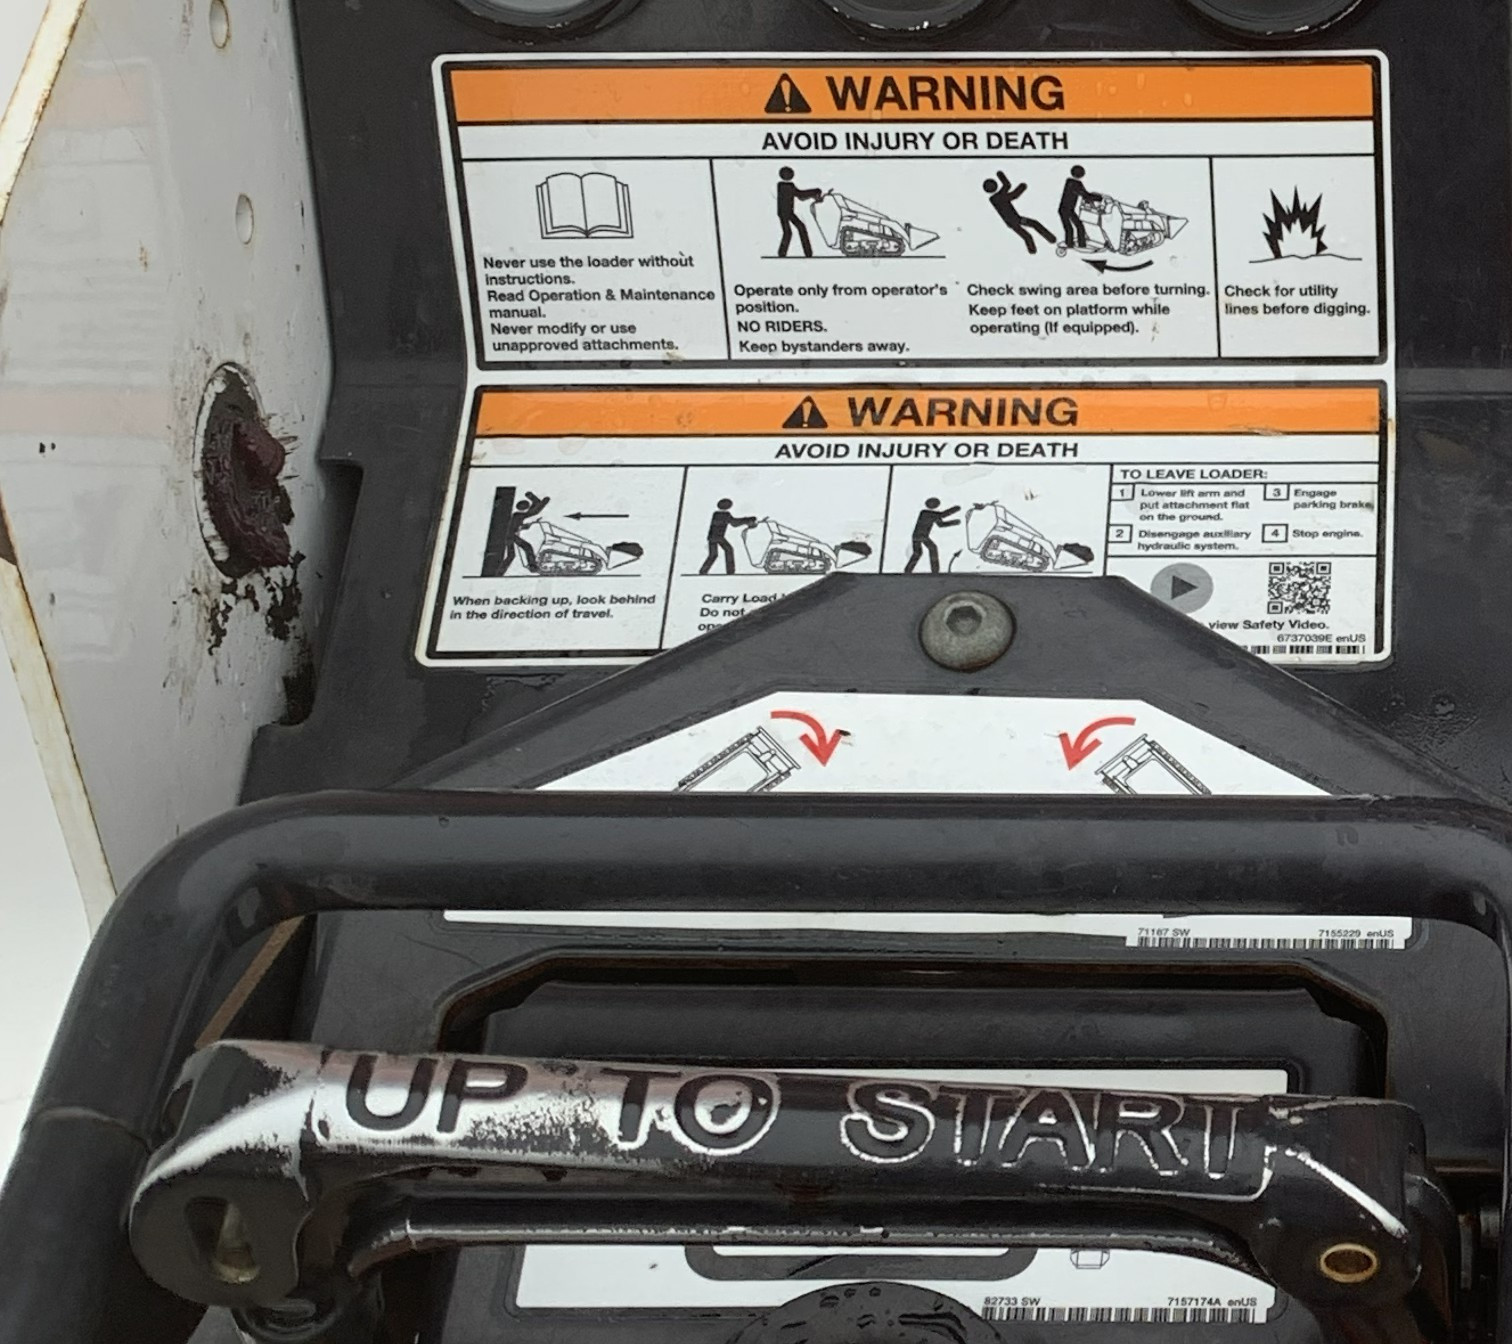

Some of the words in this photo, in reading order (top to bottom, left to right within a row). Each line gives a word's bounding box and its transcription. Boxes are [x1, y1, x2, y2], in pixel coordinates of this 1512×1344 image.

[825, 75, 1065, 111] WARNING
[762, 131, 837, 150] AVOID
[846, 131, 935, 150] INJURY
[943, 131, 978, 150] OR
[986, 131, 1068, 150] DEATH
[484, 256, 525, 269] Never
[530, 257, 555, 268] use
[560, 255, 583, 268] the
[588, 255, 634, 268] loader
[639, 255, 695, 268] without
[485, 273, 576, 286] instructions.
[487, 289, 524, 302] Read
[529, 288, 600, 303] Operation
[605, 288, 616, 301] &
[620, 288, 716, 301] Maintenance
[734, 284, 793, 299] Operate
[798, 284, 828, 298] only
[832, 284, 867, 296] from
[872, 283, 948, 298] operator's
[967, 283, 1015, 296] Check
[1019, 283, 1062, 298] swing
[1066, 286, 1098, 296] area
[1102, 283, 1150, 296] before
[1154, 283, 1210, 298] turning.
[1224, 285, 1270, 297] Check
[1275, 285, 1296, 296] for
[1299, 284, 1338, 299] utility
[489, 307, 546, 319] manual.
[736, 301, 799, 316] position.
[968, 304, 1006, 317] Keep
[1011, 303, 1039, 316] feet
[1044, 306, 1062, 316] on
[1066, 303, 1128, 318] platform
[1132, 303, 1170, 316] while
[1225, 302, 1259, 315] lines
[1263, 303, 1309, 315] before
[1313, 302, 1371, 317] digging.
[491, 322, 533, 335] Never
[537, 322, 586, 336] modify
[590, 324, 606, 334] or
[610, 324, 637, 334] use
[737, 320, 761, 333] NO
[765, 320, 828, 333] RIDERS.
[970, 322, 1040, 336] operating
[1062, 321, 1139, 336] equipped).
[492, 339, 578, 353] unapproved
[582, 338, 679, 351] attachments.
[739, 340, 777, 354] Keep
[781, 340, 863, 354] bystanders
[867, 343, 910, 354] away.
[847, 396, 1078, 427] WARNING
[775, 442, 849, 459] AVOID
[857, 442, 947, 459] INJURY
[954, 442, 989, 458] OR
[997, 442, 1078, 458] DEATH
[1120, 469, 1142, 480] TO
[1147, 469, 1195, 480] LEAVE
[1200, 468, 1268, 480] LOADER:
[1119, 488, 1125, 498] 1
[1140, 488, 1177, 498] Lower
[1180, 488, 1194, 498] lift
[1198, 490, 1221, 498] arm
[1223, 488, 1245, 498] and
[1272, 488, 1281, 498] 3
[1294, 489, 1337, 499] Engage
[1116, 529, 1124, 538] 2
[1138, 530, 1200, 540] Disengage
[1271, 529, 1279, 538] 4
[1292, 529, 1319, 539] Stop
[453, 596, 490, 606] When
[494, 595, 548, 607] backing
[552, 596, 572, 607] up,
[576, 595, 606, 605] look
[610, 594, 656, 605] behind
[701, 593, 740, 605] Carry
[742, 592, 777, 603] Load
[450, 610, 462, 620] in
[466, 609, 487, 620] the
[491, 609, 551, 619] direction
[554, 609, 569, 619] of
[573, 608, 614, 619] travel.
[700, 607, 719, 617] Do
[723, 607, 745, 617] not
[1208, 620, 1238, 630] view
[1243, 620, 1285, 631] Safety
[1289, 620, 1330, 630] Video.
[1277, 633, 1332, 643] 6737039E
[1336, 633, 1366, 643] enUS
[343, 1050, 532, 1136] UP
[600, 1063, 782, 1155] TO
[838, 1078, 1250, 1181] START
[983, 1296, 1018, 1306] 82733
[1021, 1296, 1041, 1306] SW
[1167, 1297, 1221, 1307] 7157174A
[1227, 1297, 1257, 1307] enUS
